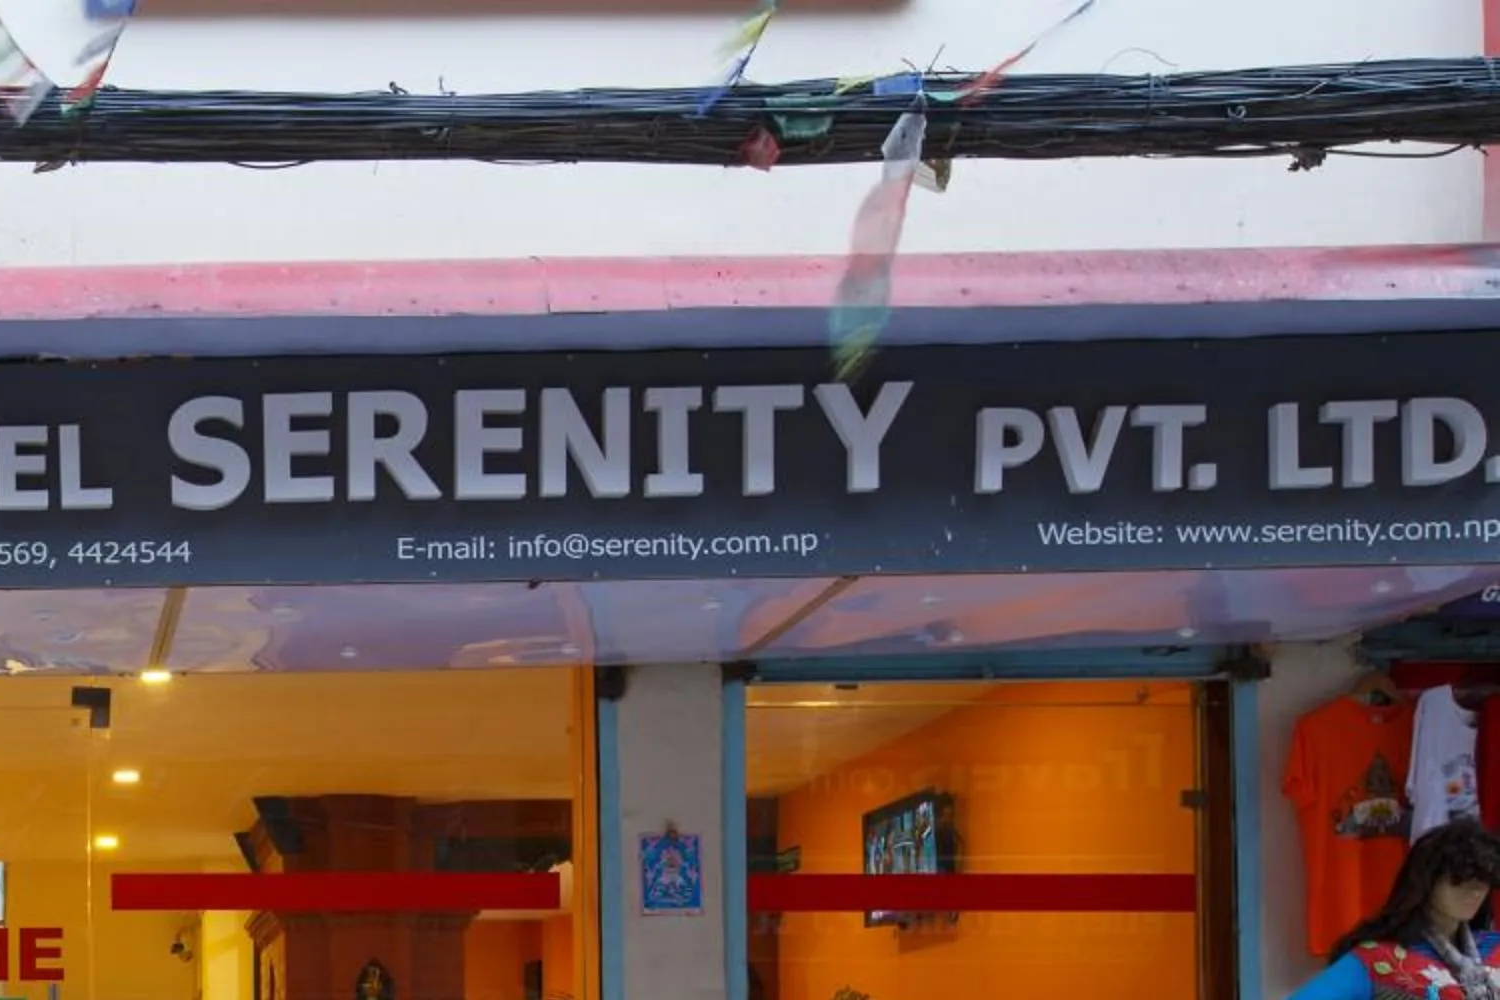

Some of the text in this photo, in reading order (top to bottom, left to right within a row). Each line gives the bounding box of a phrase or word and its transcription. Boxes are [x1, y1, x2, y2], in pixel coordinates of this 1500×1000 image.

[167, 381, 915, 511] SERENITY
[974, 405, 1218, 493] PVT.
[396, 532, 819, 560] E-mail: info@serenity.com.np
[1038, 516, 1500, 547] Website: www.serenity.com.np
[67, 540, 192, 564] 4424544
